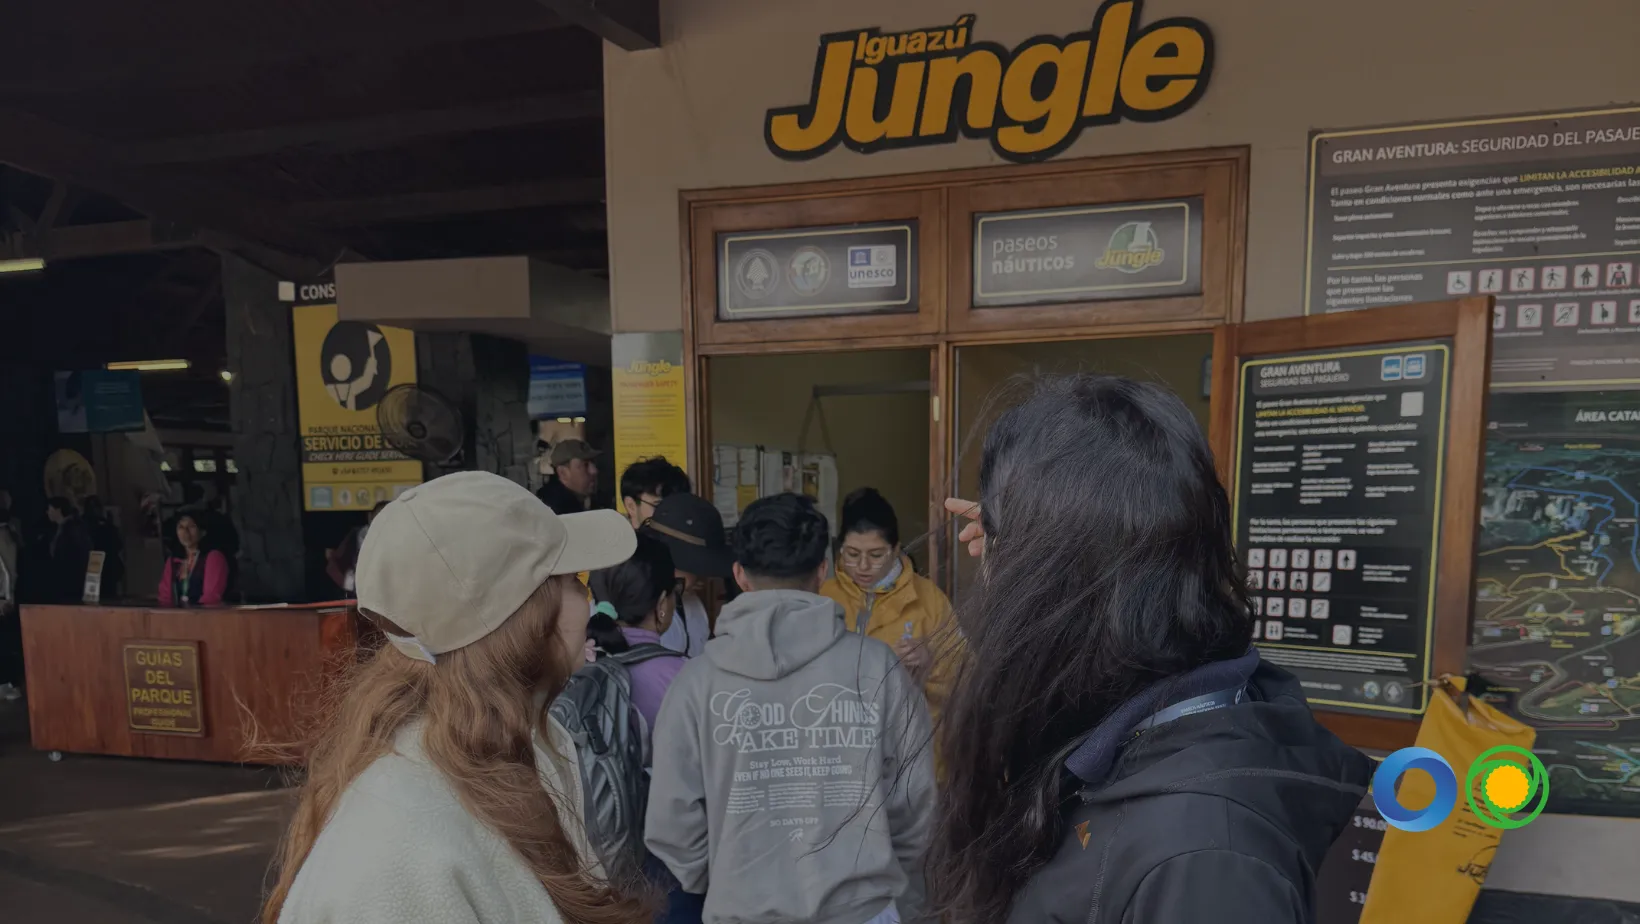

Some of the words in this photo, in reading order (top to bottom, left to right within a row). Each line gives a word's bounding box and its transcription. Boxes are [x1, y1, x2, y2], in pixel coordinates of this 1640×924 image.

[856, 15, 968, 64] Iguazú
[771, 1, 1205, 153] Jungle
[1333, 148, 1373, 164] GRAN
[1376, 142, 1458, 160] AVENTURA:
[1462, 134, 1549, 153] SEGURIDAD
[1553, 131, 1582, 147] DEL
[1586, 127, 1640, 144] PASAJE
[992, 235, 1058, 258] paseos
[1096, 249, 1165, 268] Jungle
[850, 268, 894, 280] unesco
[300, 282, 336, 300] CONS
[1260, 365, 1287, 379] GRAN
[1288, 360, 1342, 376] AVENTURA
[1575, 409, 1606, 422] ÁREA
[1608, 410, 1640, 422] CATA
[340, 424, 379, 433] NACIONA
[305, 435, 361, 451] SERVICIO
[364, 434, 382, 449] DE
[145, 669, 175, 686] DEL
[131, 688, 193, 705] PARQUE
[790, 683, 880, 729] THINGS
[804, 726, 877, 748] TIME
[749, 759, 769, 770] Stay
[792, 756, 818, 766] Work
[819, 754, 842, 765] Hard
[733, 771, 751, 782] EVEN
[751, 770, 759, 780] IF
[760, 769, 770, 780] NO
[770, 768, 784, 778] ONE
[785, 767, 803, 777] SEES
[812, 766, 830, 776] KEEP
[831, 765, 852, 775] GOING
